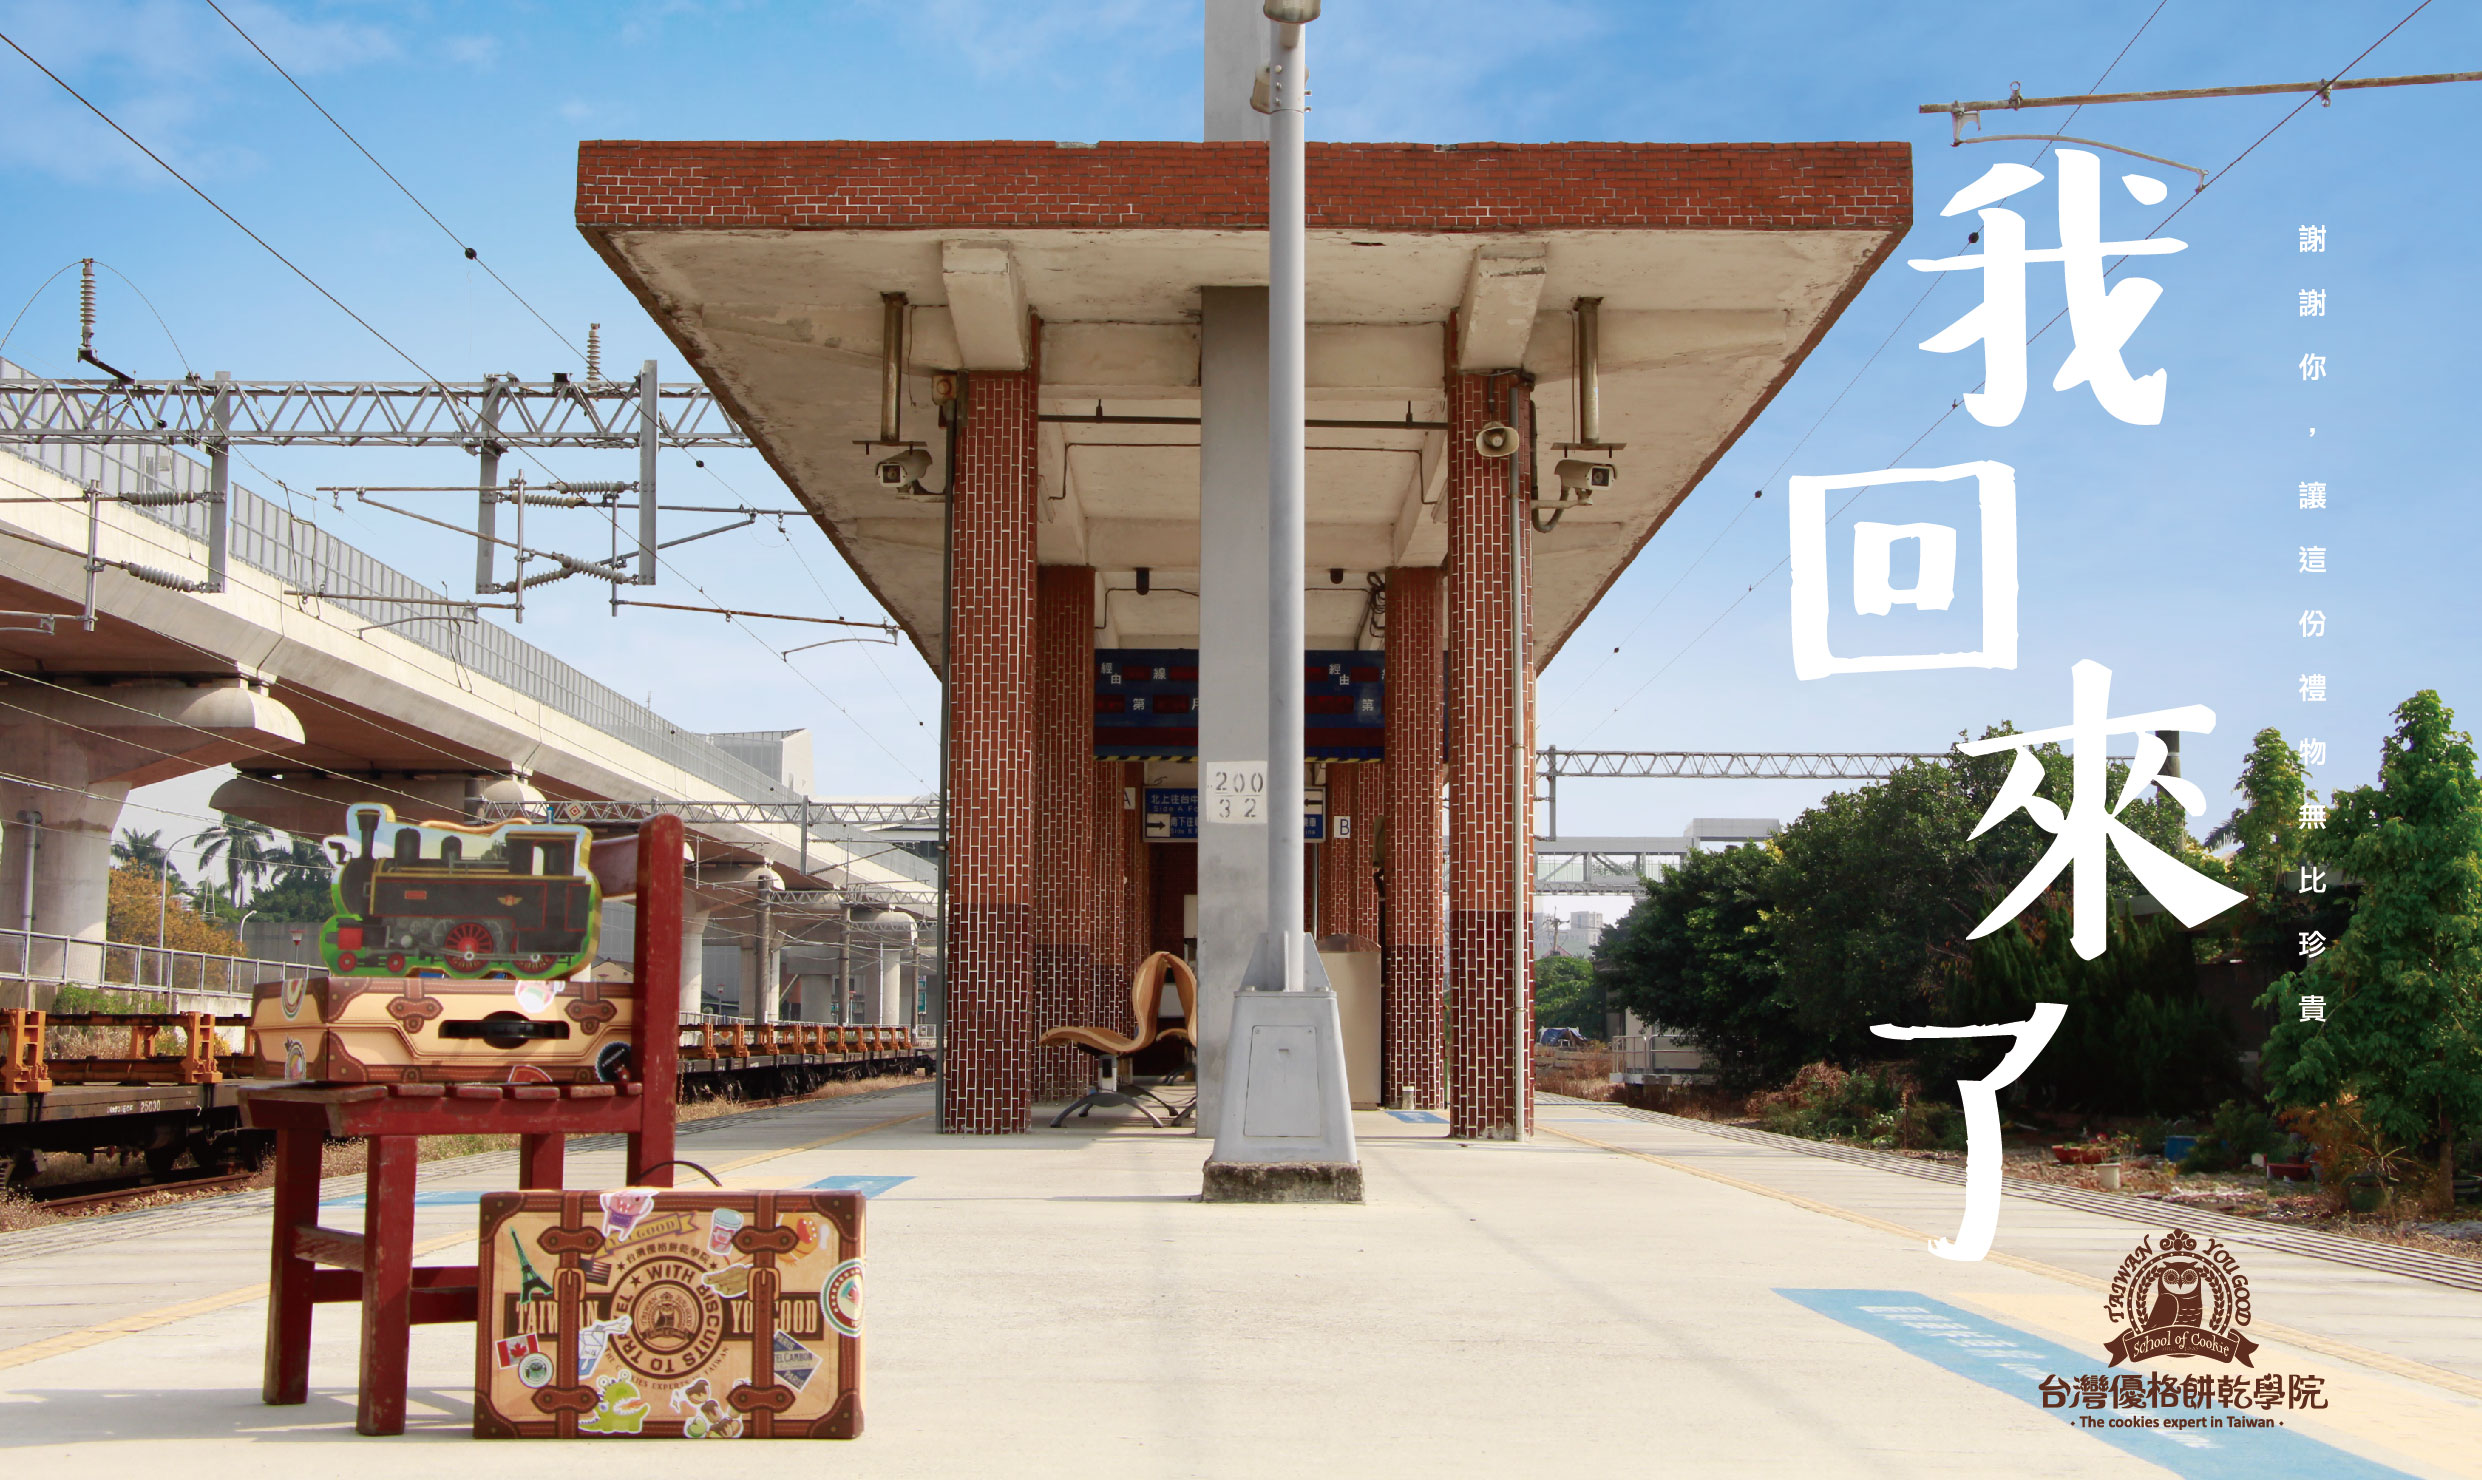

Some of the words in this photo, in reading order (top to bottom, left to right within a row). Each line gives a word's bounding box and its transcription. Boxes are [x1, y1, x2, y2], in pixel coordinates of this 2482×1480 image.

[1101, 662, 1121, 685] 經由
[1153, 667, 1166, 680] 線
[1328, 663, 1350, 686] 經由
[1132, 698, 1145, 710] 第
[1361, 698, 1375, 711] 第
[1215, 772, 1264, 793] 200
[1340, 818, 1350, 835] B
[646, 1264, 696, 1284] WITH
[516, 1301, 600, 1334] TAIWN
[682, 1284, 720, 1367] BISCUITS
[613, 1294, 643, 1364] TREL
[650, 1358, 674, 1373] TO
